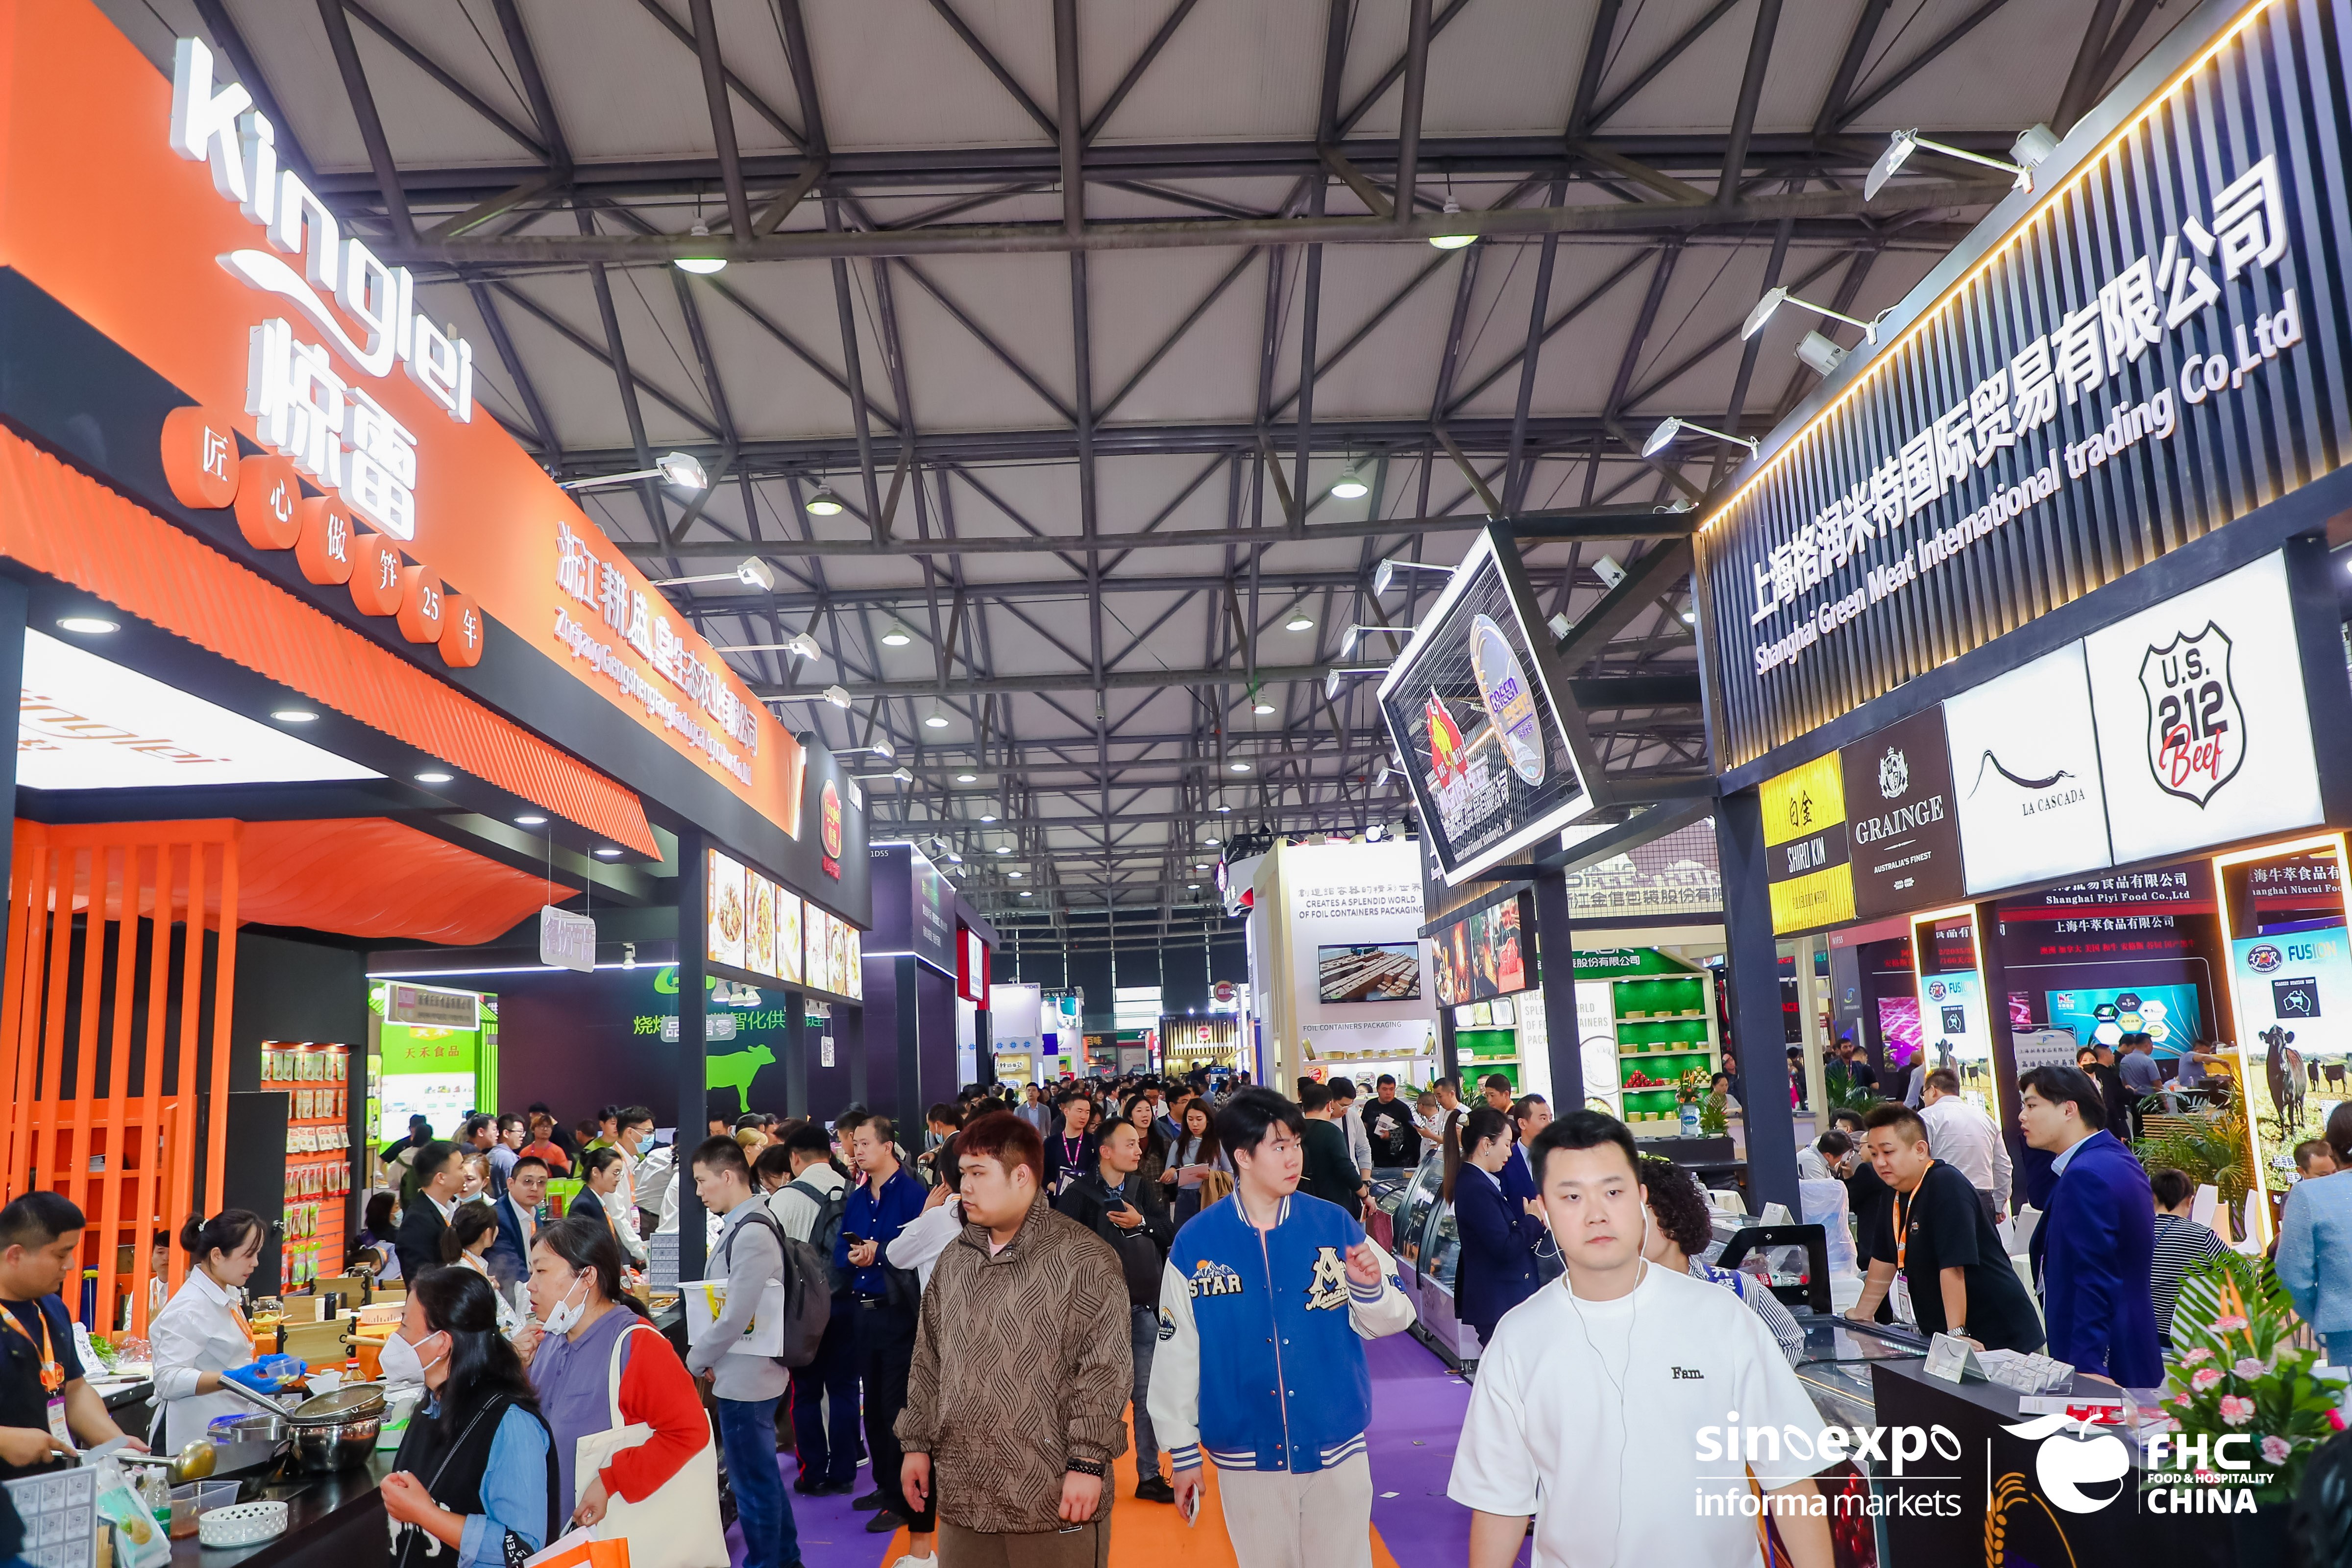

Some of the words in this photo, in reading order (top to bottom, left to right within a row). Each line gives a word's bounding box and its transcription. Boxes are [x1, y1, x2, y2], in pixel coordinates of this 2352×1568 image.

[169, 36, 473, 424] kinglei
[1751, 153, 2289, 626] 上海格润米特国际贸易有限公司
[244, 316, 418, 541] 惊雷
[1755, 610, 1818, 675] Shanghai
[1818, 575, 1867, 635] Green
[1868, 555, 1916, 603] Meat
[1916, 448, 2061, 583] International
[2064, 388, 2176, 479] trading
[2162, 648, 2210, 688] U.S.
[2158, 681, 2229, 750] 212
[2158, 723, 2223, 788] Beef
[1789, 790, 1813, 827] 白金
[2022, 803, 2035, 817] LA
[2037, 787, 2085, 813] CASCADA
[1855, 795, 1945, 845] GRAINGE
[1787, 840, 1810, 873] SHIRO
[1810, 836, 1826, 867] KIN
[1874, 856, 1910, 874] AUSTRALIA'S
[1911, 851, 1932, 865] FINEST
[2053, 873, 2188, 891] 易食品有限公司
[2251, 865, 2340, 882] 海牛萃食品有
[1814, 889, 1828, 905] WAGYU
[2046, 894, 2094, 905] Shanghai
[2098, 893, 2118, 903] Piyi
[2122, 892, 2148, 901] Food
[2152, 890, 2190, 901] Co.,Ltd
[2253, 886, 2287, 896] anghai
[2291, 884, 2323, 894] Niucui
[2325, 883, 2342, 892] Foo
[1299, 910, 1310, 919] OF
[1311, 910, 1328, 918] FOIL
[1330, 908, 1379, 917] CONTAINERS
[1381, 906, 1424, 915] PACKAGING
[1306, 899, 1340, 908] CREATES
[1348, 897, 1386, 906] SPLENDID
[1388, 895, 1416, 904] WORLD
[2055, 915, 2175, 933] 上海牛萃食品有限公司
[2288, 941, 2337, 961] FUSION
[405, 1045, 459, 1059] 天禾食品
[1189, 1274, 1243, 1298] STAR
[1671, 1366, 1704, 1379] Fam.
